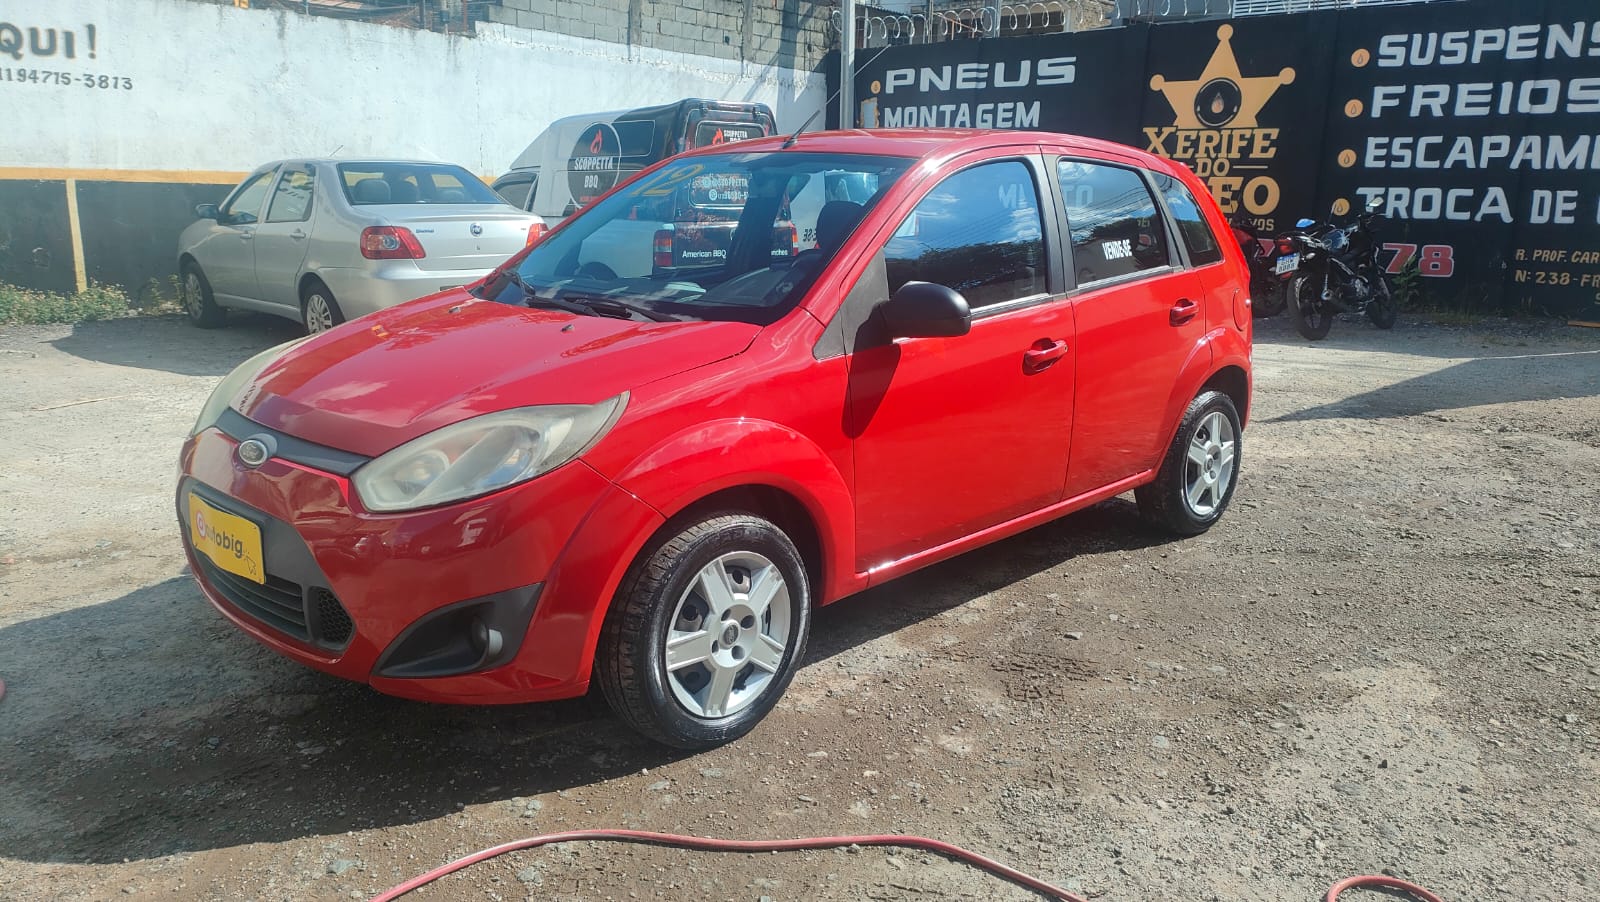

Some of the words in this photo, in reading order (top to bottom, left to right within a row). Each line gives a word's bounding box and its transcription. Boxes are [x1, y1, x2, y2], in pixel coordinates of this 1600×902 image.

[885, 57, 1077, 94] PNEUS
[1371, 78, 1600, 118] FREIOS
[884, 101, 1041, 129] MONTAGEM
[1143, 127, 1280, 158] XERIFE
[574, 156, 613, 171] SCOPPETTA
[1195, 158, 1230, 177] DO
[584, 175, 599, 188] BBQ
[1356, 186, 1513, 223] TROCA
[1530, 189, 1578, 224] DE
[682, 250, 712, 258] American
[712, 249, 727, 259] BBQ
[1101, 239, 1133, 260] VENDE-SE
[1532, 249, 1568, 263] PROF.
